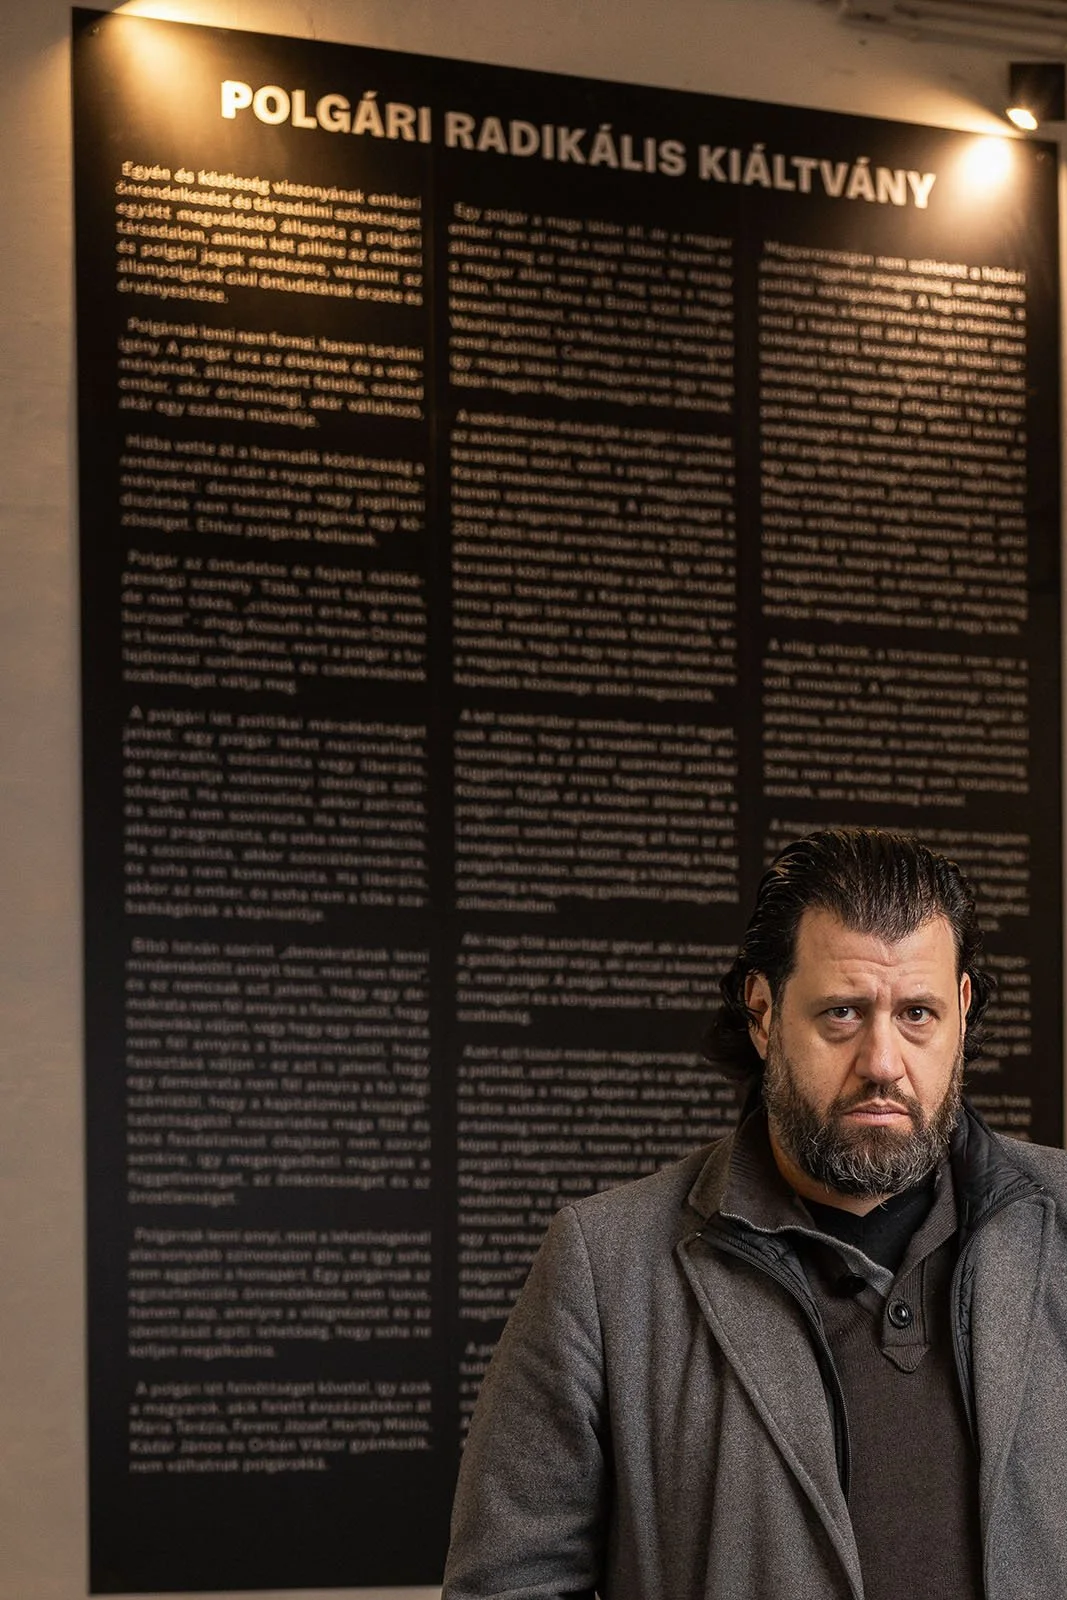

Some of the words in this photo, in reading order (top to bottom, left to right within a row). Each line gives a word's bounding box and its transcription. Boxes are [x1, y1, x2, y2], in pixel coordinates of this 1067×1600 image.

[221, 80, 432, 143] POLGÁRI
[445, 110, 687, 176] RADIKÁLIS
[698, 143, 937, 209] KIÁLTVÁNY
